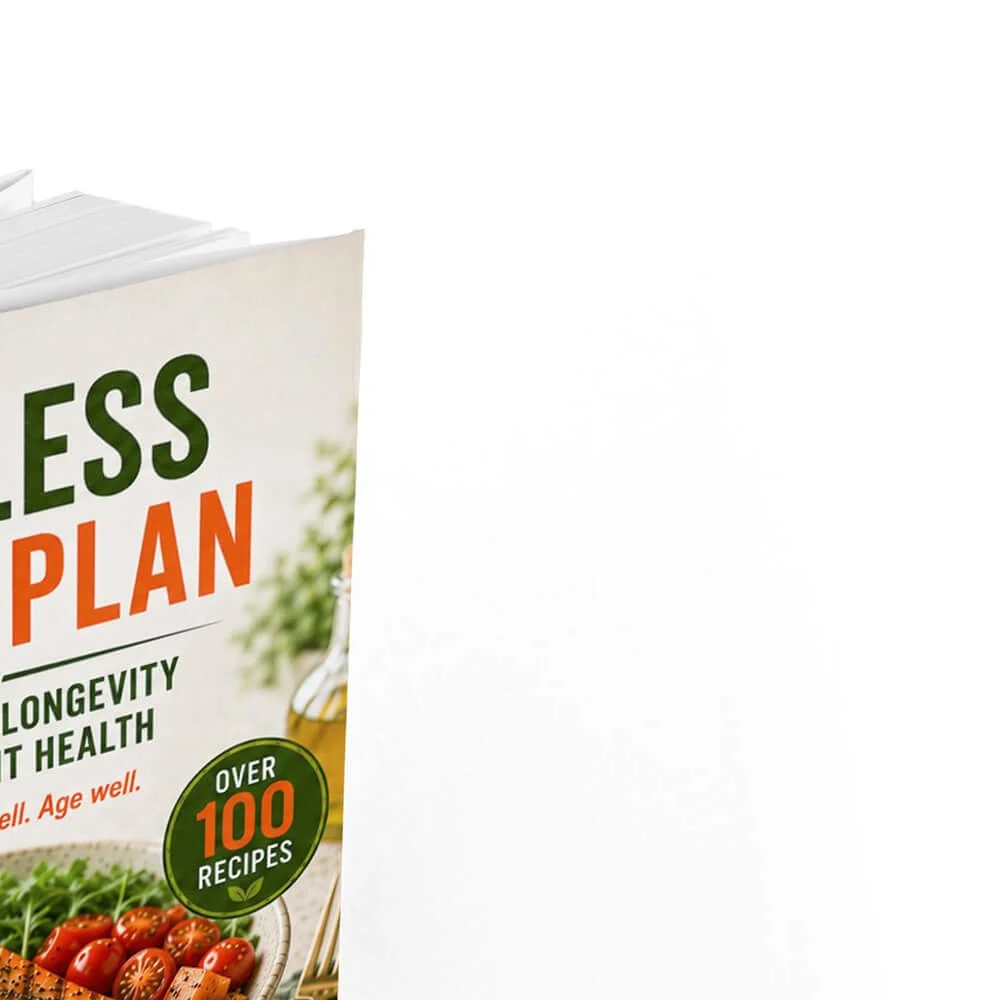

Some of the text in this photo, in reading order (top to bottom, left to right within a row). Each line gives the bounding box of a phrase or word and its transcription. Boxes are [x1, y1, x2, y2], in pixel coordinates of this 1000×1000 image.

[11, 480, 253, 647] PLAN
[1, 655, 179, 737] LONGEVITY
[35, 707, 154, 773] HEALTH
[37, 792, 83, 821] Age
[91, 769, 141, 804] well.
[215, 755, 276, 794] OVER
[196, 779, 295, 859] 100
[198, 839, 293, 890] RECIPES
